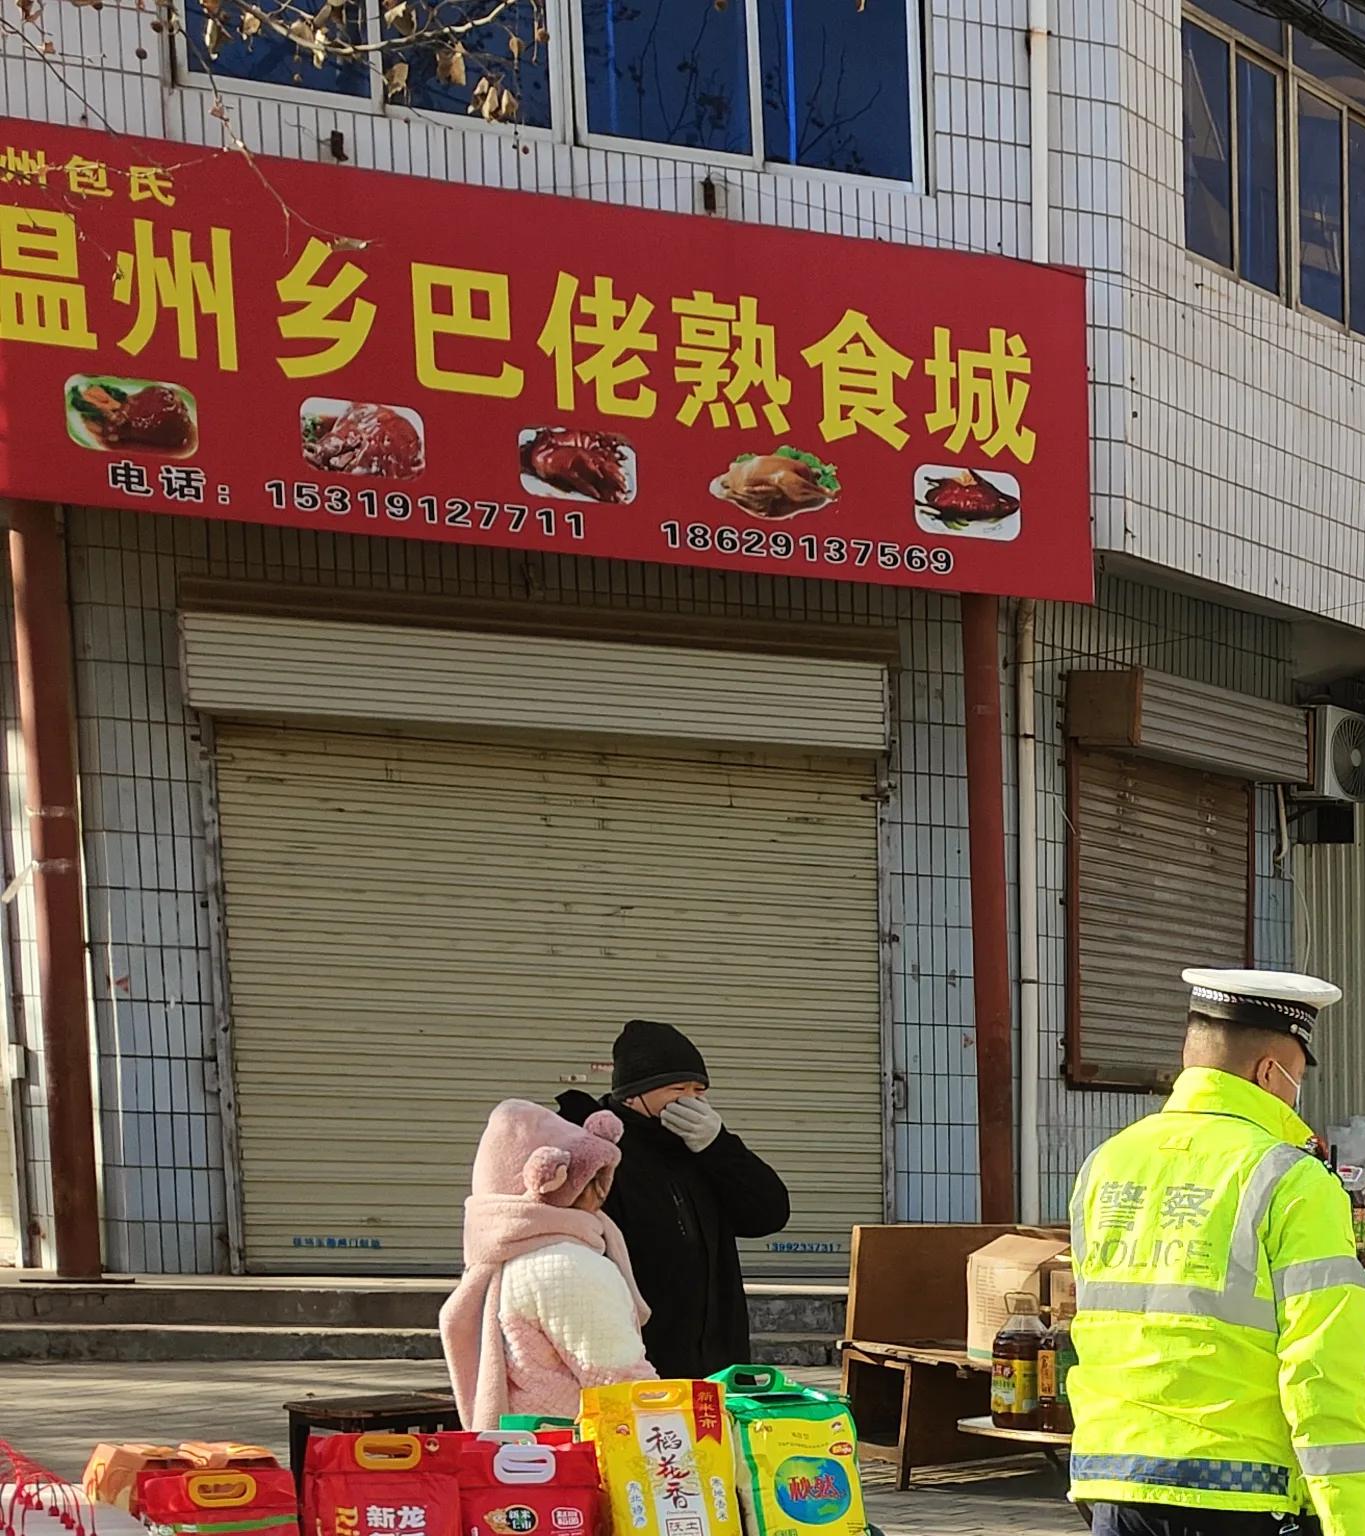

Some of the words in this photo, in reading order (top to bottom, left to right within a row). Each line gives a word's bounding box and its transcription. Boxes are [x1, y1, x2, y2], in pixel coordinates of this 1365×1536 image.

[0, 205, 1037, 465] 温州乡巴佬熟食城
[660, 520, 955, 575] 18629137569
[1098, 1180, 1215, 1232] 警察
[645, 1426, 700, 1510] 稻花香
[366, 1504, 427, 1529] 新龙
